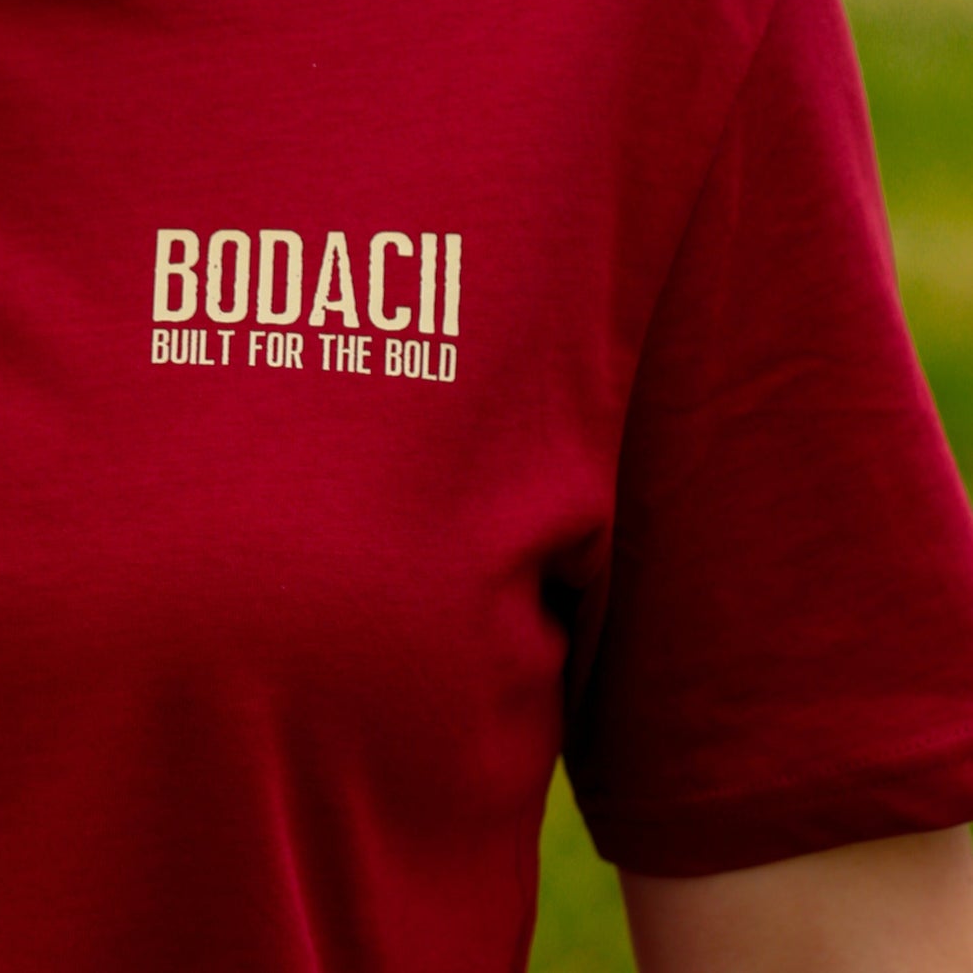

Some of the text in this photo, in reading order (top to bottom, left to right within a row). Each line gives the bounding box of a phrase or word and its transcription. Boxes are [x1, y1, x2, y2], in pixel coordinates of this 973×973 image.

[152, 228, 462, 337] BODACII
[151, 328, 457, 383] BUILT FOR THE BOLD
